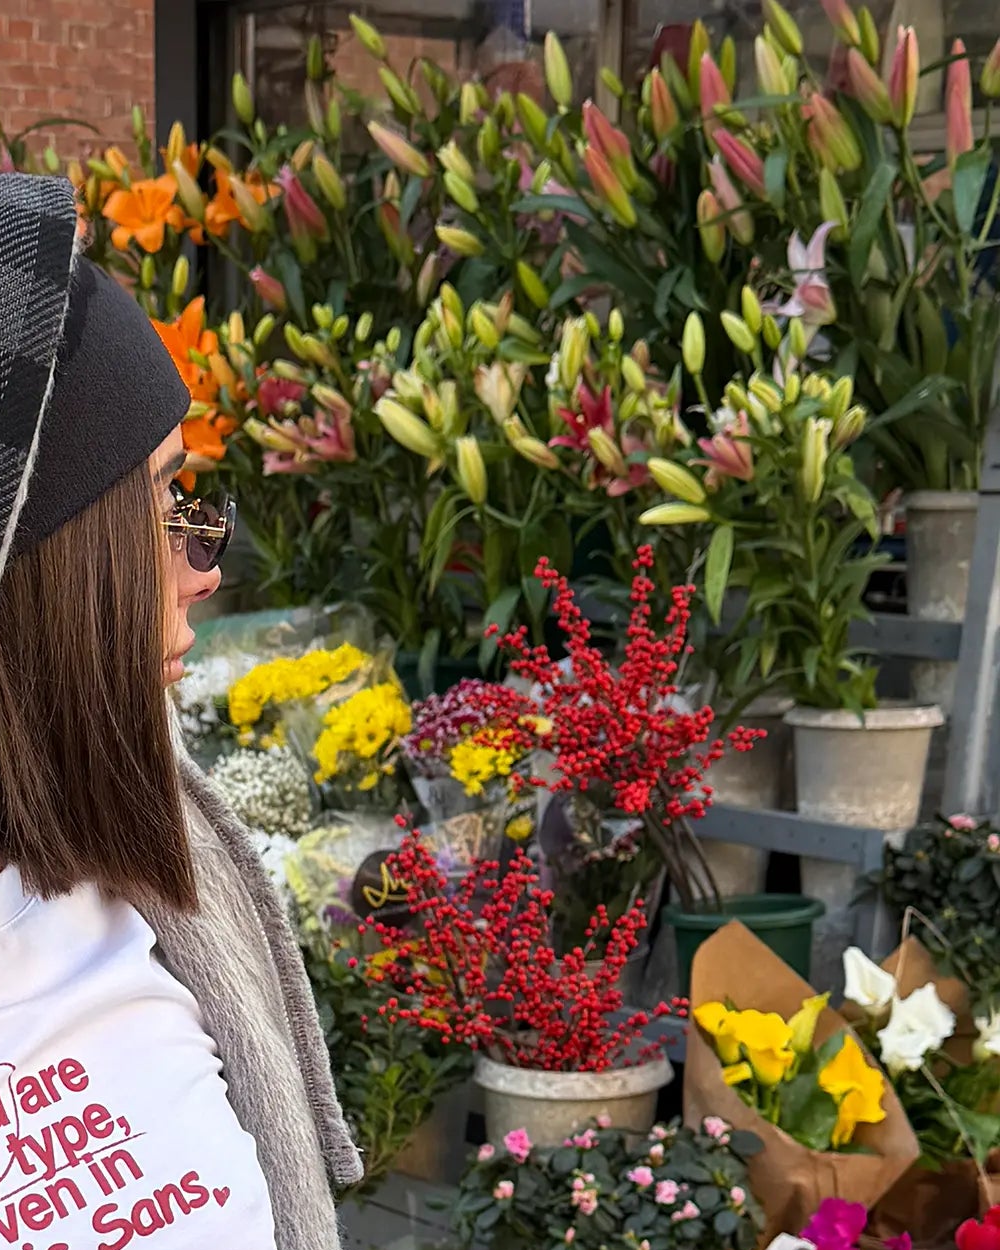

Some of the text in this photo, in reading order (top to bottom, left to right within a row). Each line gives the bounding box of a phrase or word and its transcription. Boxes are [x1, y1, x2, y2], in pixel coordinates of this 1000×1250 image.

[16, 1058, 89, 1114] are
[6, 1103, 131, 1181] type,
[81, 1148, 144, 1196] in
